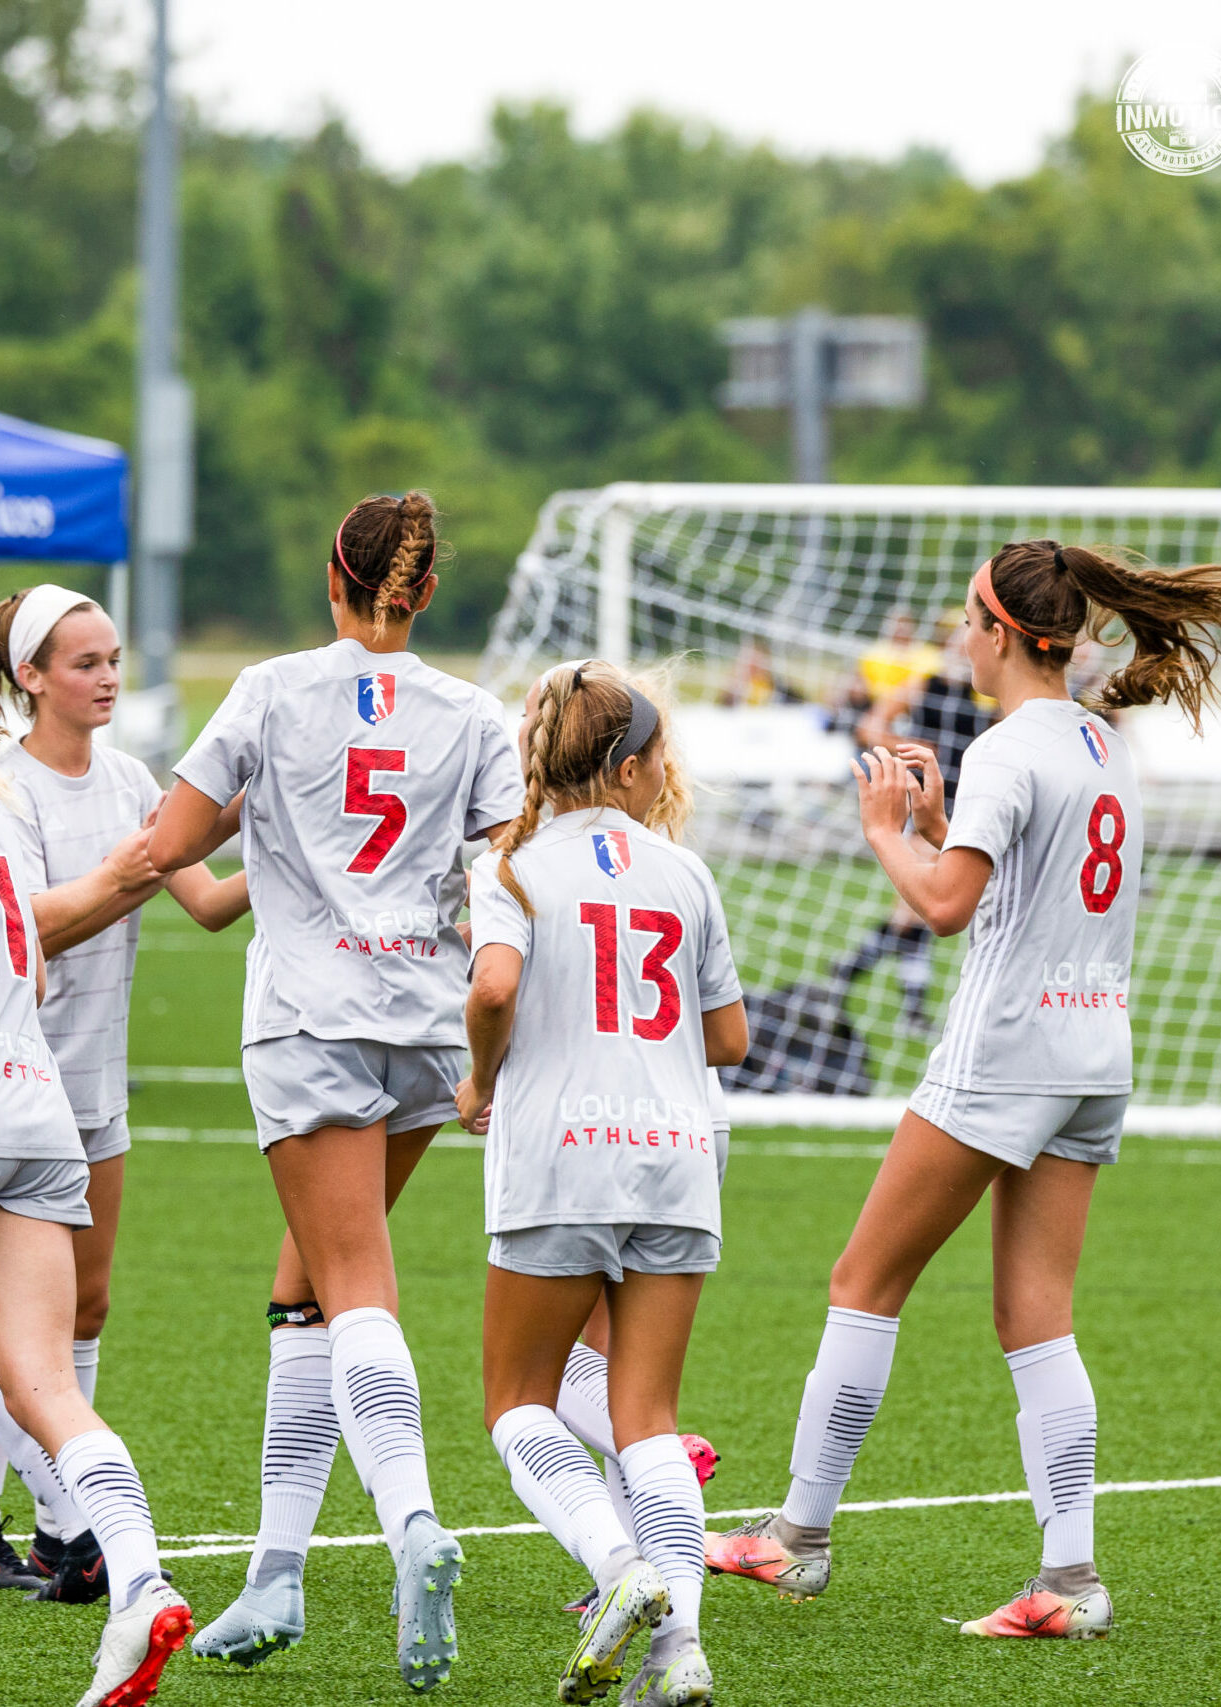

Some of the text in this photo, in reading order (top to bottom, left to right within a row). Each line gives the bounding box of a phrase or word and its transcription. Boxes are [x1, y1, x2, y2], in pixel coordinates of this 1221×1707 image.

[340, 744, 411, 878] 5
[1078, 791, 1127, 917] 8
[577, 901, 684, 1046] 13
[1040, 991, 1127, 1009] ATHLETC
[560, 1094, 627, 1123] LOU
[562, 1126, 709, 1154] ATHLETIC
